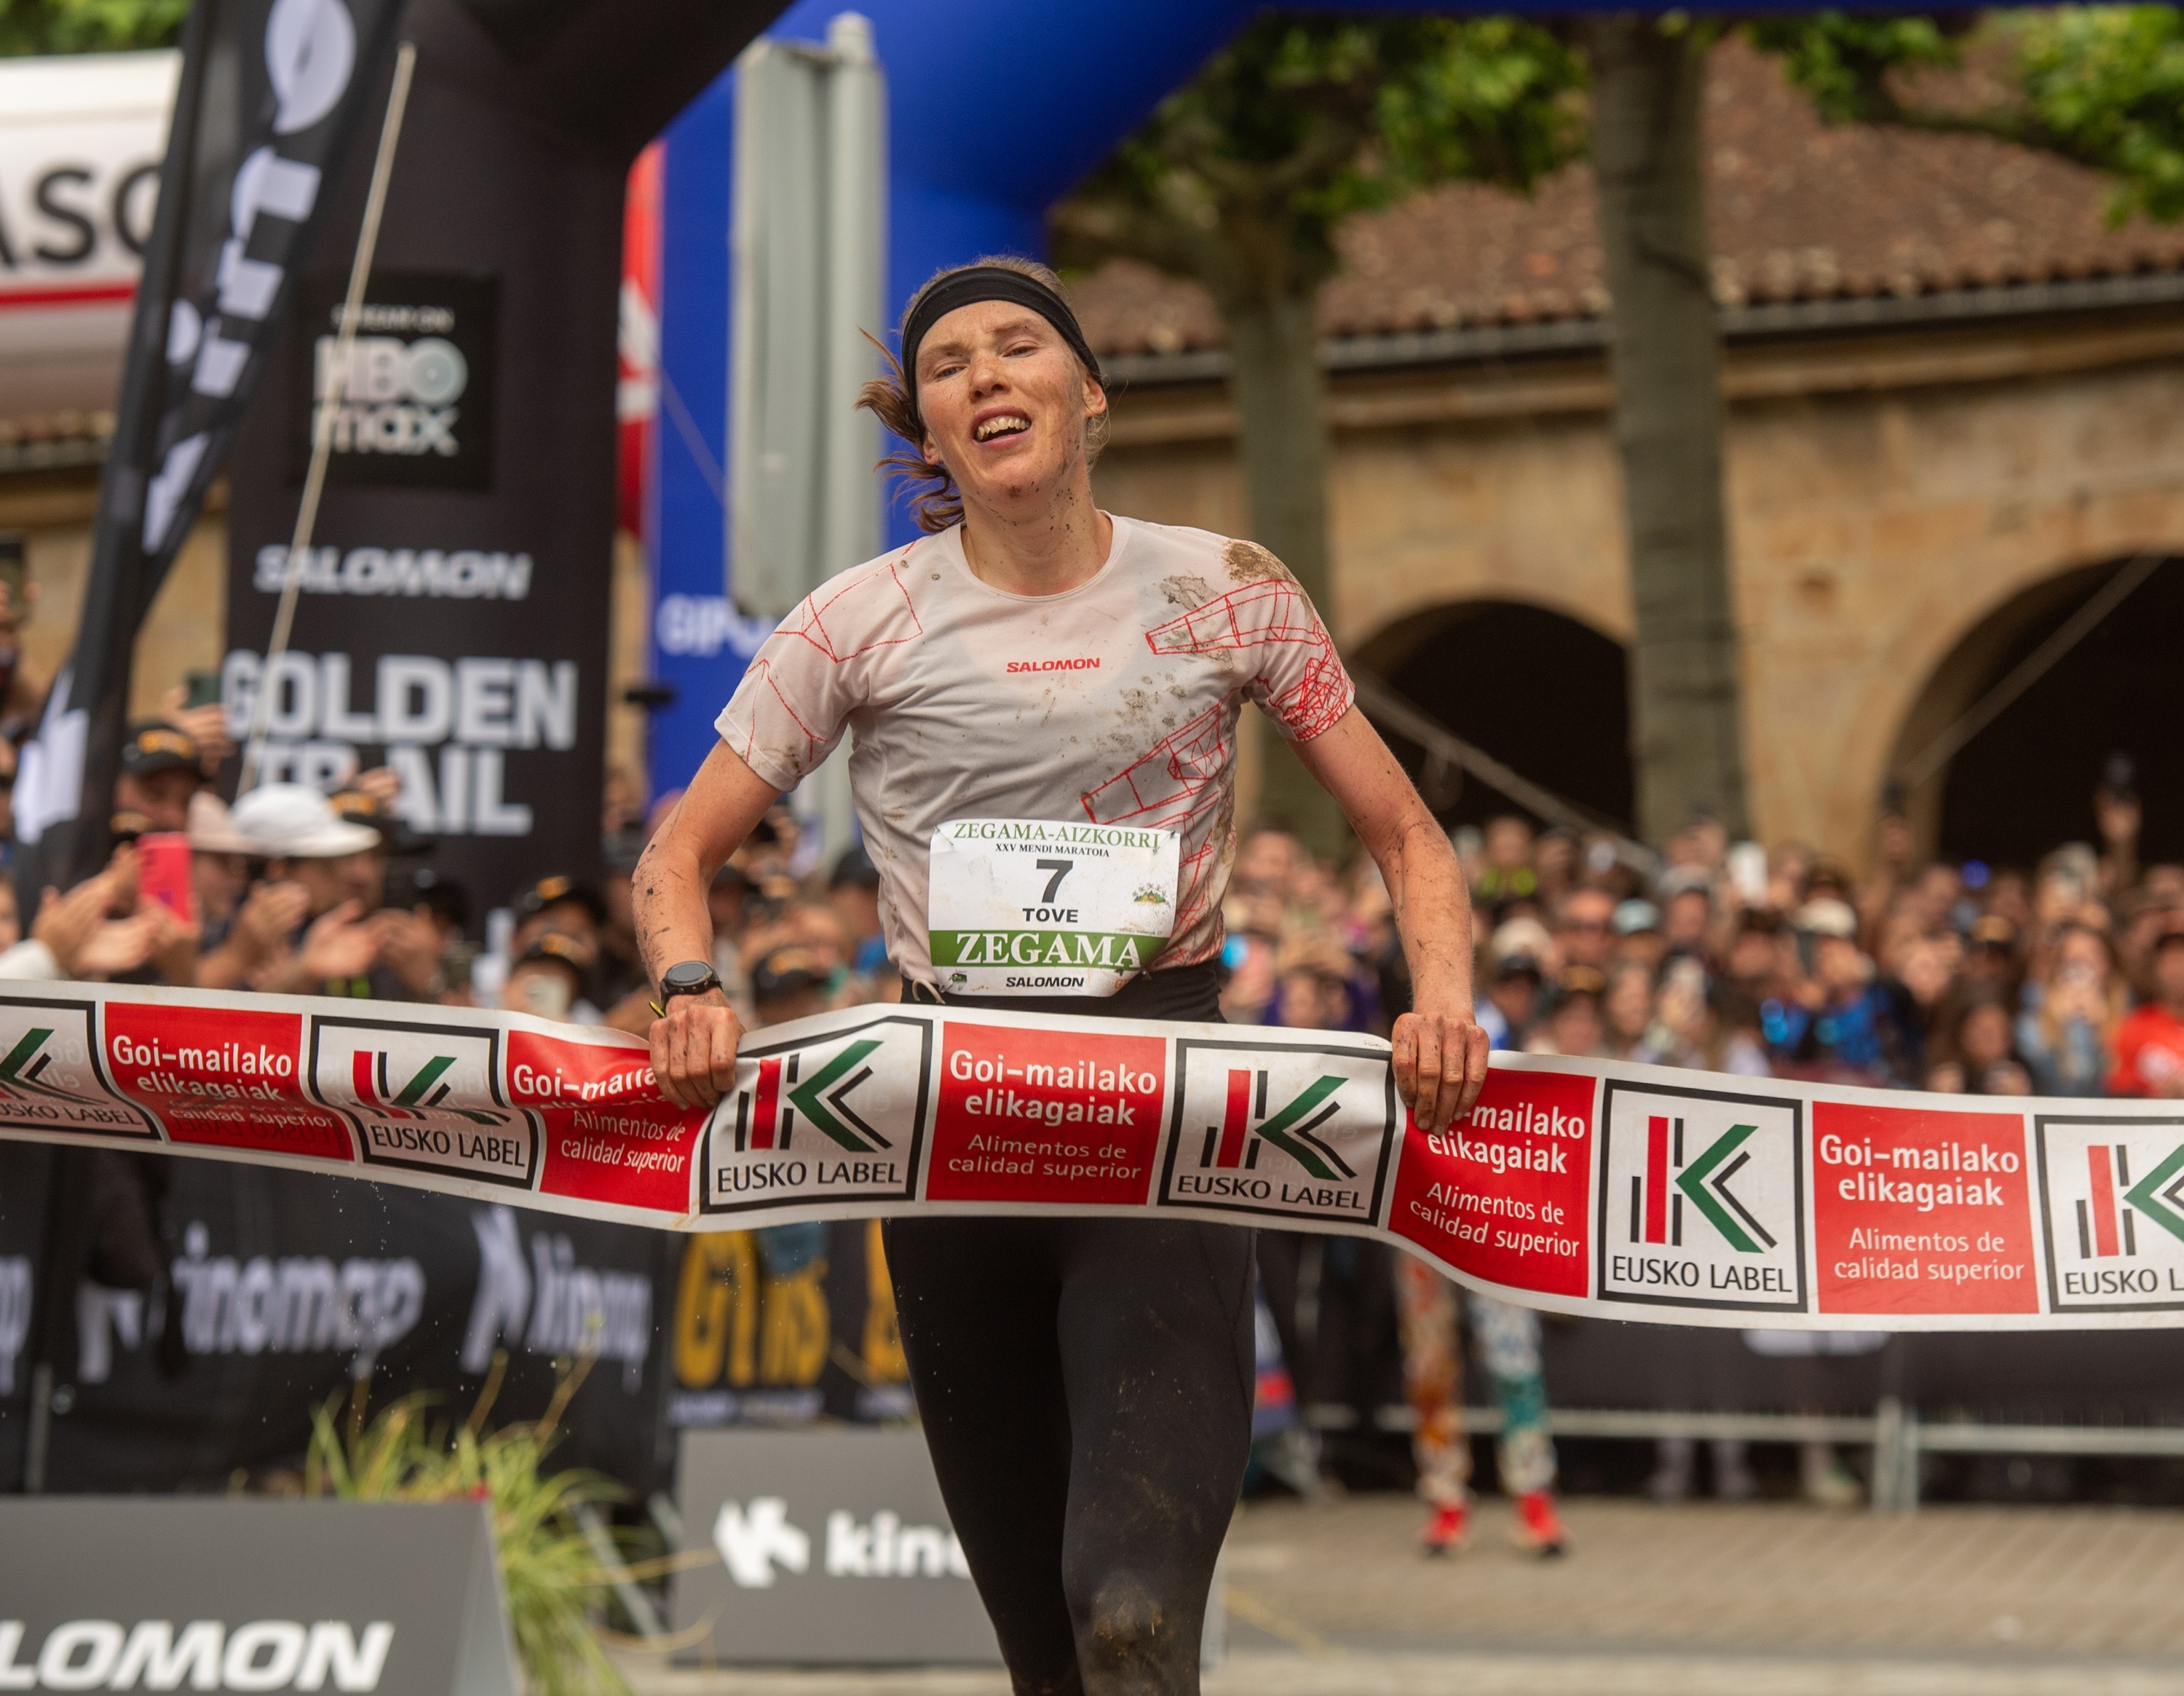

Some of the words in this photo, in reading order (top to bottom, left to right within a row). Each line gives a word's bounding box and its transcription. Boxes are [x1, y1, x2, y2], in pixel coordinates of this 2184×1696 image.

[313, 335, 468, 406] HBO
[254, 544, 533, 599] SALOMON
[1007, 658, 1101, 673] SALOMON
[221, 648, 579, 749] GOLDEN
[251, 741, 534, 837] TRAIL
[953, 822, 1161, 849] ZEGAMA-AIZKORRI
[995, 843, 1017, 853] XXV
[1019, 845, 1053, 854] MENDI
[1055, 845, 1110, 858] MARATOIA
[1036, 859, 1074, 904] 7
[1022, 908, 1079, 923] TOVE
[956, 933, 1142, 969] ZEGAMA
[1005, 977, 1085, 987] SALOMON
[112, 1035, 291, 1077] Goi-mailako
[950, 1049, 1157, 1094] Goi-mailako
[137, 1070, 285, 1102] elikagaiak
[63, 1107, 143, 1126] LABEL
[170, 1108, 245, 1123] calidad
[250, 1111, 334, 1128] superior
[965, 1088, 1136, 1127] elikagaiak
[574, 1110, 666, 1140] Alimentos
[666, 1121, 686, 1142] de
[370, 1125, 451, 1155] EUSKO
[458, 1132, 525, 1167] LABEL
[561, 1137, 625, 1166] calidad
[624, 1148, 686, 1174] superior
[968, 1134, 1089, 1157] Alimentos
[1099, 1144, 1127, 1159] de
[1428, 1129, 1567, 1174] elikagaiak
[1820, 1134, 2019, 1173] Goi-mailako
[717, 1161, 807, 1193] EUSKO
[817, 1162, 903, 1185] LABEL
[949, 1156, 1034, 1175] calidad
[1042, 1163, 1142, 1180] superior
[1177, 1175, 1271, 1199] EUSKO
[1281, 1183, 1366, 1210] LABEL
[1427, 1183, 1535, 1220] Alimentos
[1541, 1201, 1564, 1225] de
[1838, 1172, 2005, 1212] elikagaiak
[1409, 1200, 1489, 1244] calidad
[1494, 1229, 1580, 1257] superior
[1848, 1228, 1970, 1252] Alimentos
[1977, 1231, 2006, 1253] de
[1613, 1255, 1699, 1287] EUSKO
[1711, 1264, 1792, 1293] LABEL
[1834, 1257, 1919, 1279] calidad
[1926, 1259, 2025, 1285] superior
[2065, 1269, 2159, 1295] EUSKO
